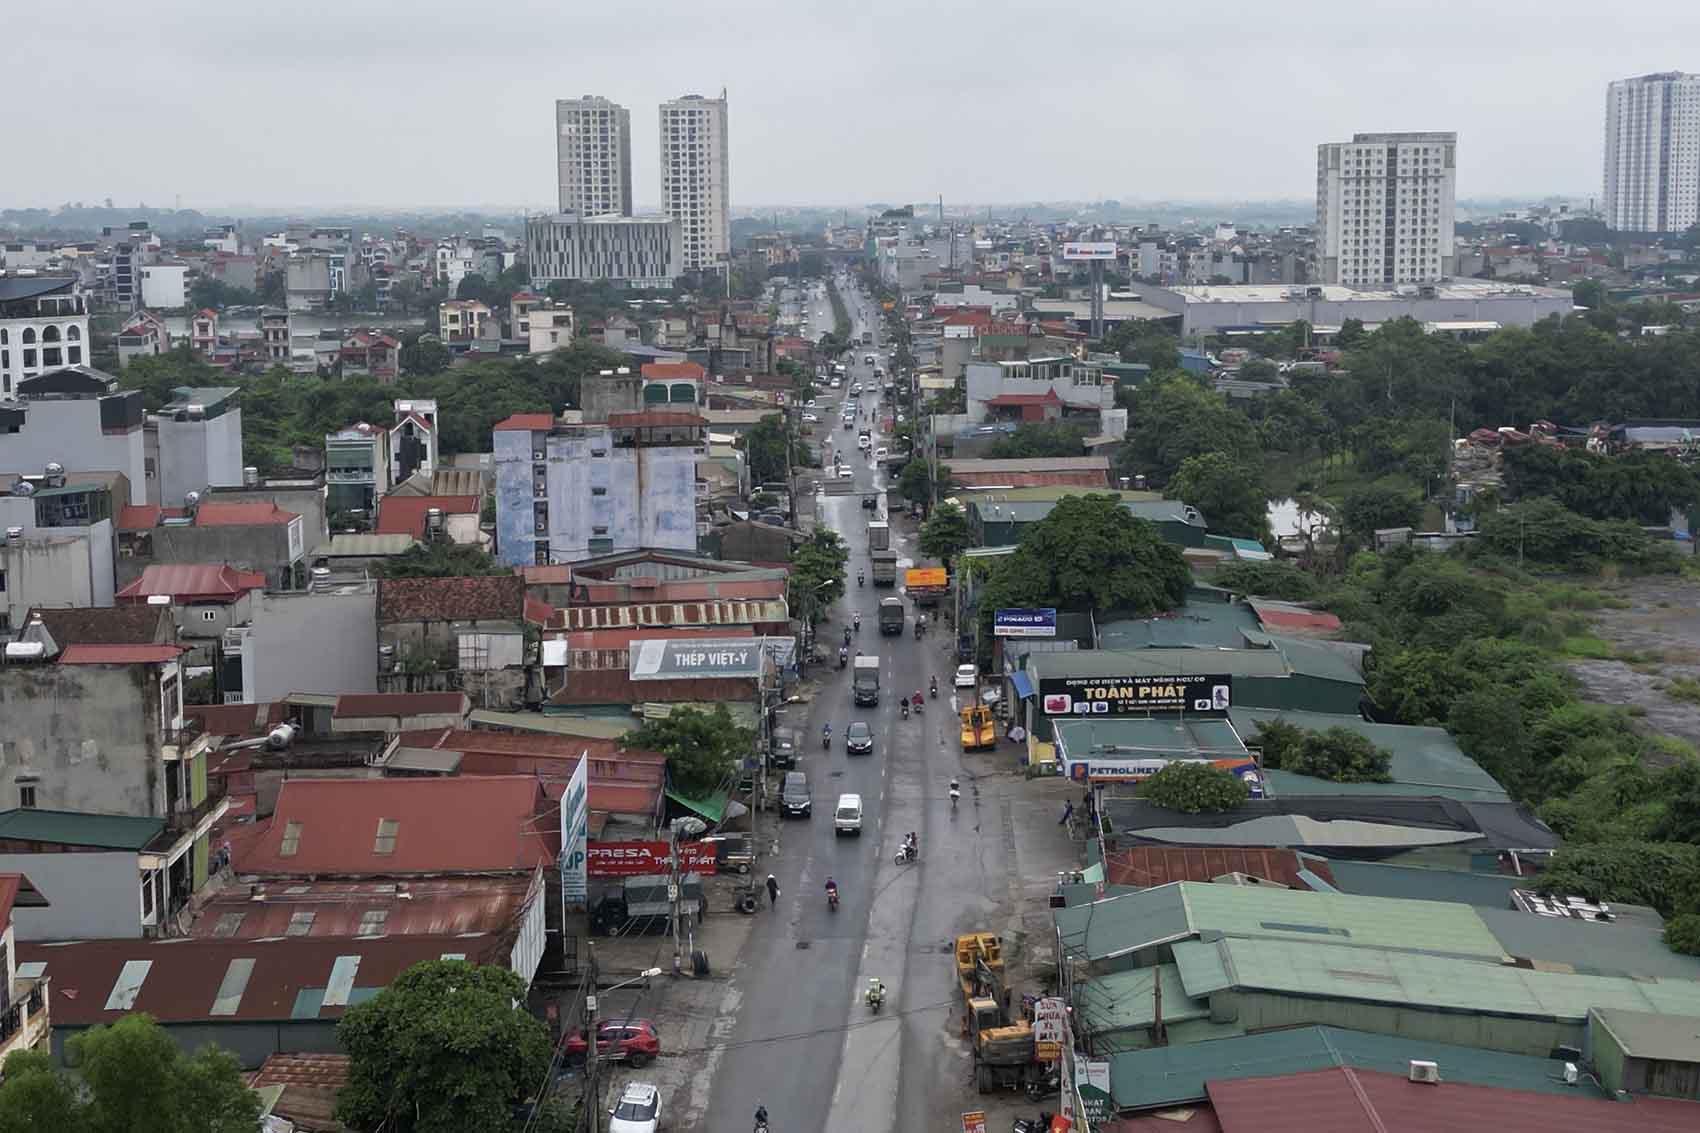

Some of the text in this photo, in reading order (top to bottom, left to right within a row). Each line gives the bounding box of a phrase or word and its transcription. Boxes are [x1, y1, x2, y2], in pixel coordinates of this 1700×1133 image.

[674, 650, 705, 666] THÉP
[1139, 683, 1186, 698] PHÁT
[588, 848, 652, 857] PRESA
